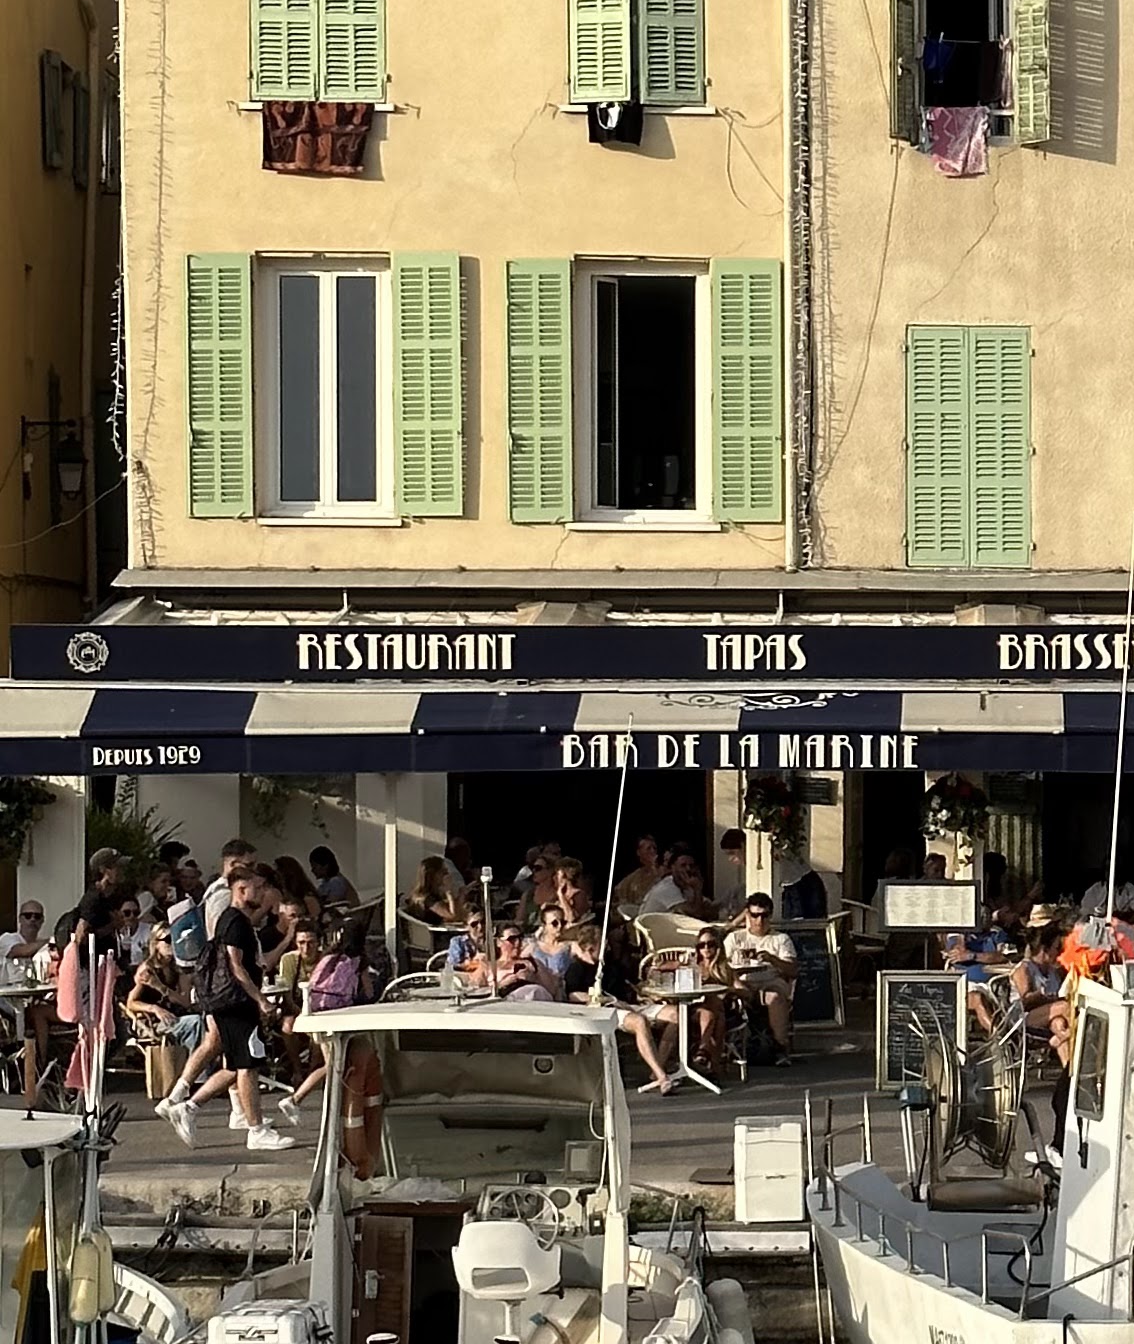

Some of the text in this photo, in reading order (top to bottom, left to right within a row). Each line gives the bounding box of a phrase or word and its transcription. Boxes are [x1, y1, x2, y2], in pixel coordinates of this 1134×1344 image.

[296, 633, 517, 671] RESTAURANT
[702, 633, 808, 671] TAPAS
[157, 745, 201, 765] 1929
[561, 734, 920, 769] BAR DE LA MARINE
